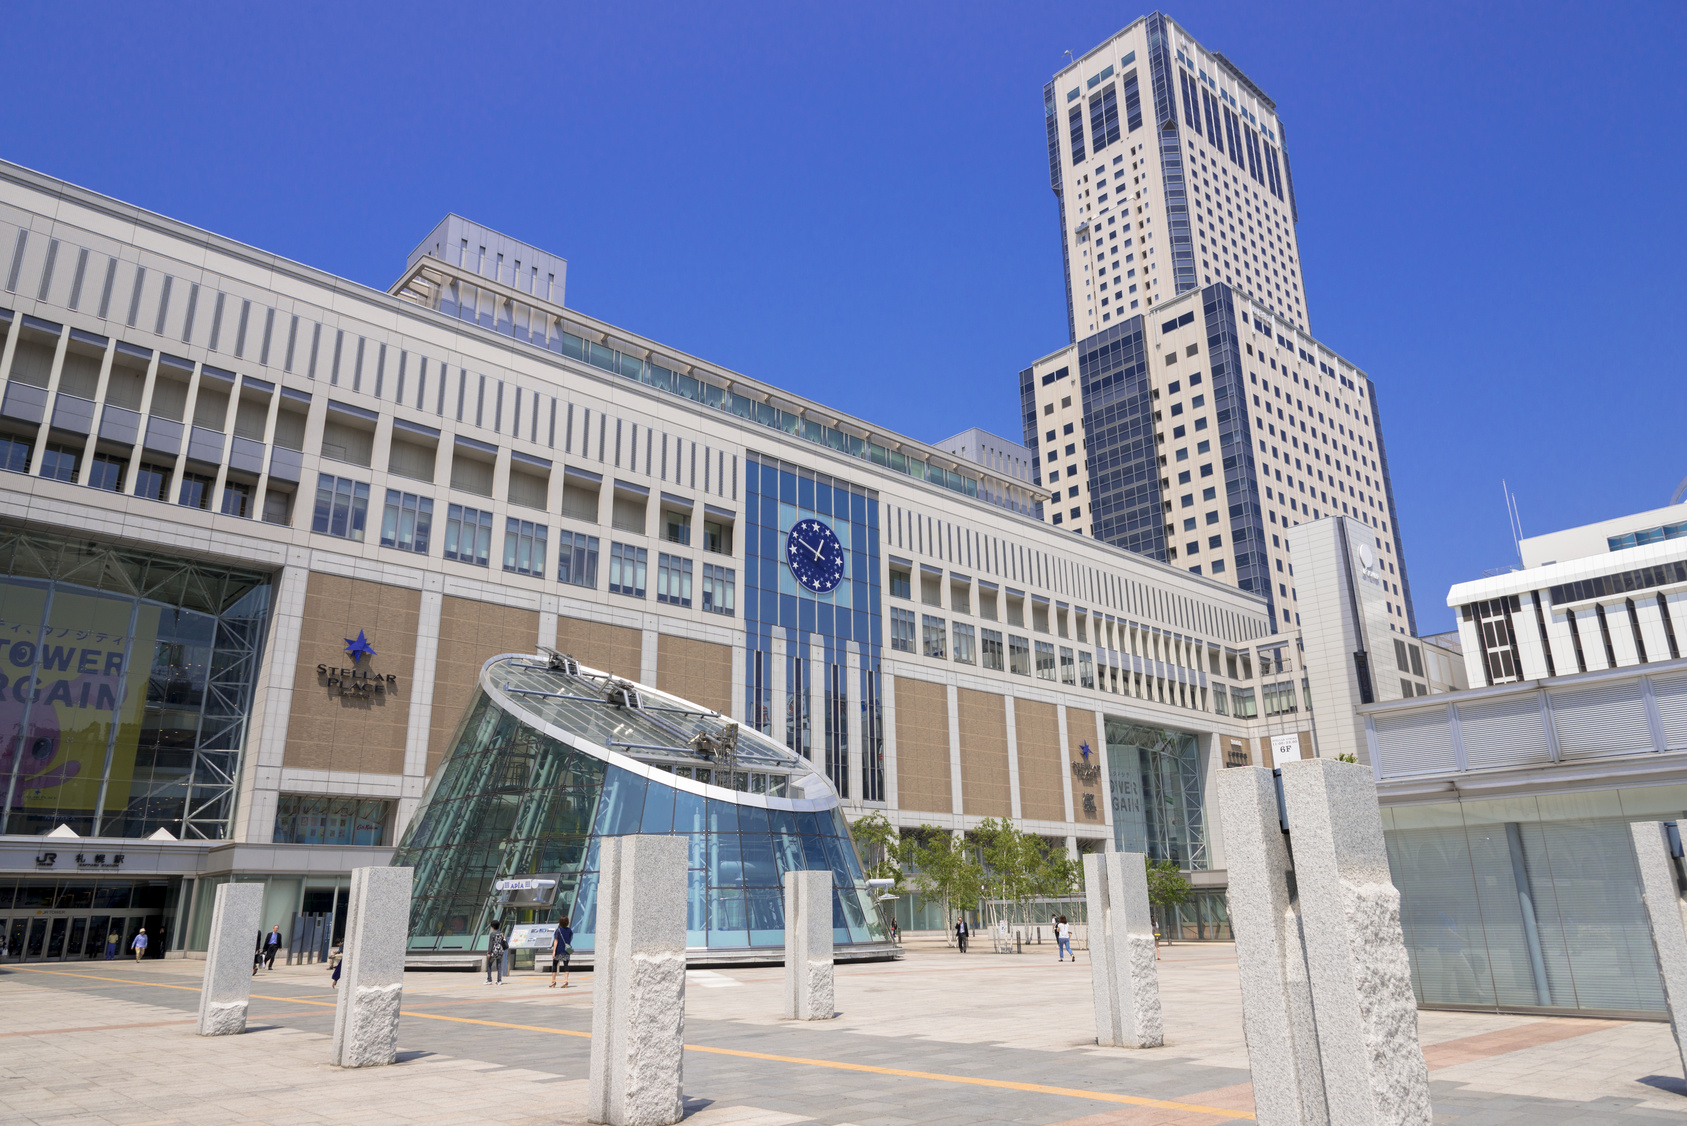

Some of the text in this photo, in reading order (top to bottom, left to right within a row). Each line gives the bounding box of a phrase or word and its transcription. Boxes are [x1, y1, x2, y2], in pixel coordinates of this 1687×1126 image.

[316, 663, 397, 683] STELLAR
[327, 677, 385, 694] PLACE
[1280, 745, 1292, 753] 6F
[36, 852, 57, 863] JR
[75, 853, 125, 863] 札幌駅
